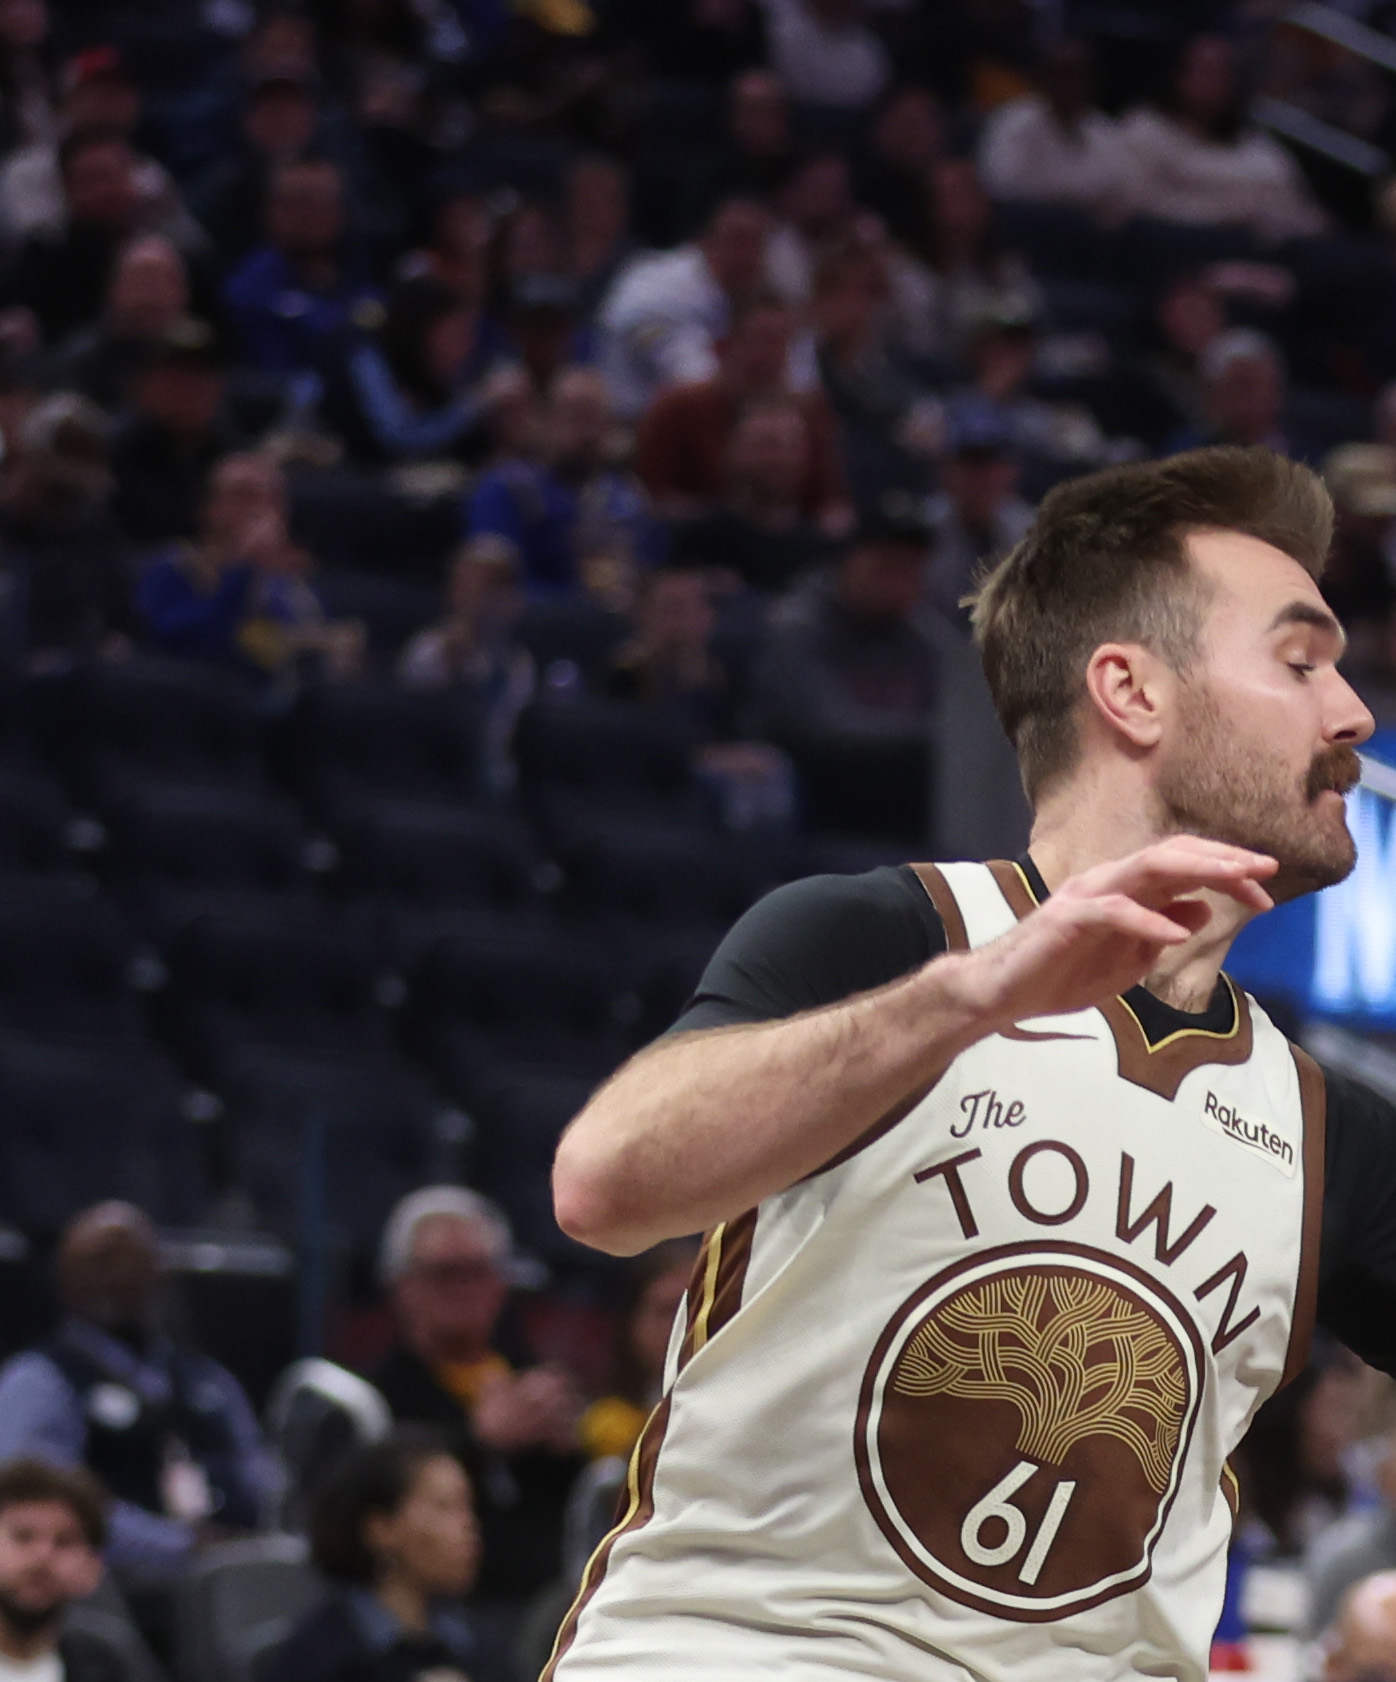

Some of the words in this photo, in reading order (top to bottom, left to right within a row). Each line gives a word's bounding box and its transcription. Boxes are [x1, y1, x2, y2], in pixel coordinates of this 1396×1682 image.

[950, 1089, 1026, 1139] The
[1203, 1090, 1295, 1166] Rakuten
[914, 1139, 1262, 1356] TOWN
[961, 1461, 1076, 1586] 61
